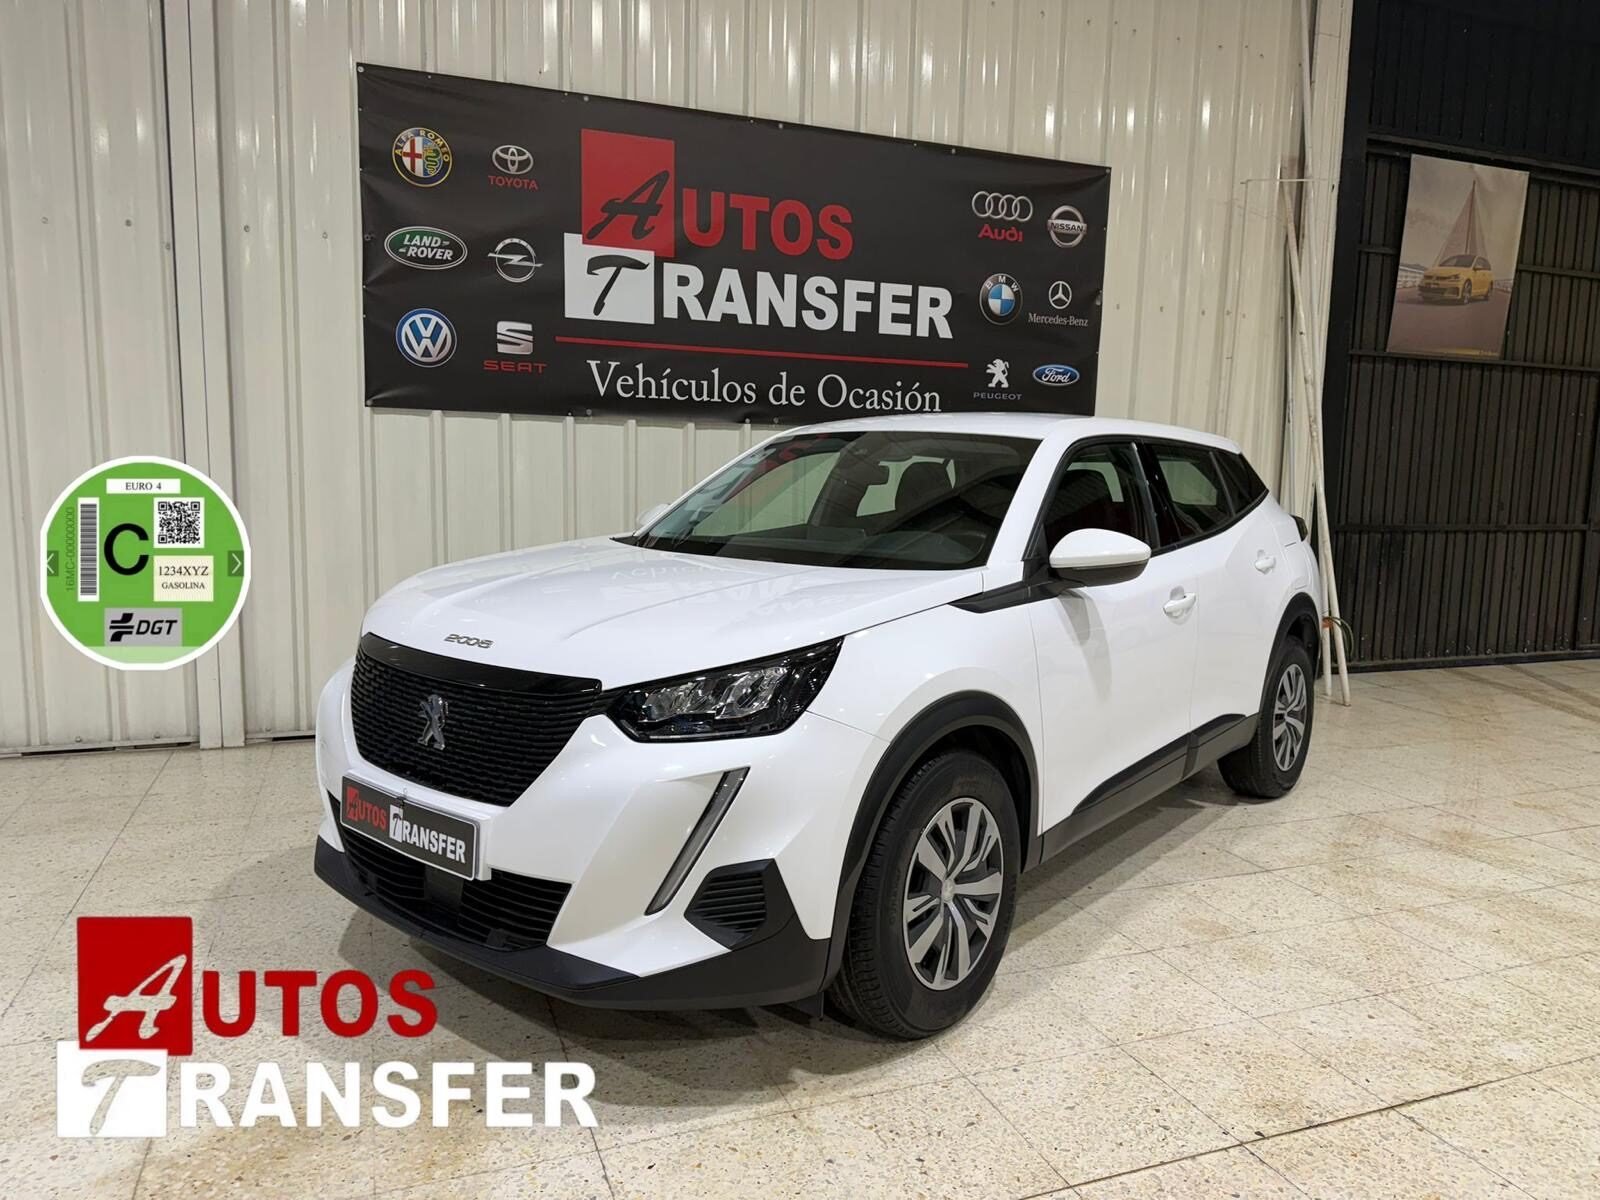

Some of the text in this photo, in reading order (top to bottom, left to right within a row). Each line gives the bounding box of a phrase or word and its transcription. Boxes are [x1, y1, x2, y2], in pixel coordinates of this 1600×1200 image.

[488, 175, 539, 190] TOYOTA
[587, 169, 854, 261] AUTOS
[1050, 222, 1084, 233] NISSAN
[403, 233, 441, 248] LAND
[407, 246, 454, 261] ROVER
[984, 275, 1020, 293] BMW
[586, 253, 954, 339] TRANSFER
[1028, 312, 1089, 327] Mercedes-Benz
[483, 359, 548, 374] SEAT
[1041, 367, 1071, 384] Ford
[586, 359, 942, 412] Vehículos de Ocasión
[973, 392, 1023, 401] PEUGEOT
[443, 633, 494, 649] 2008
